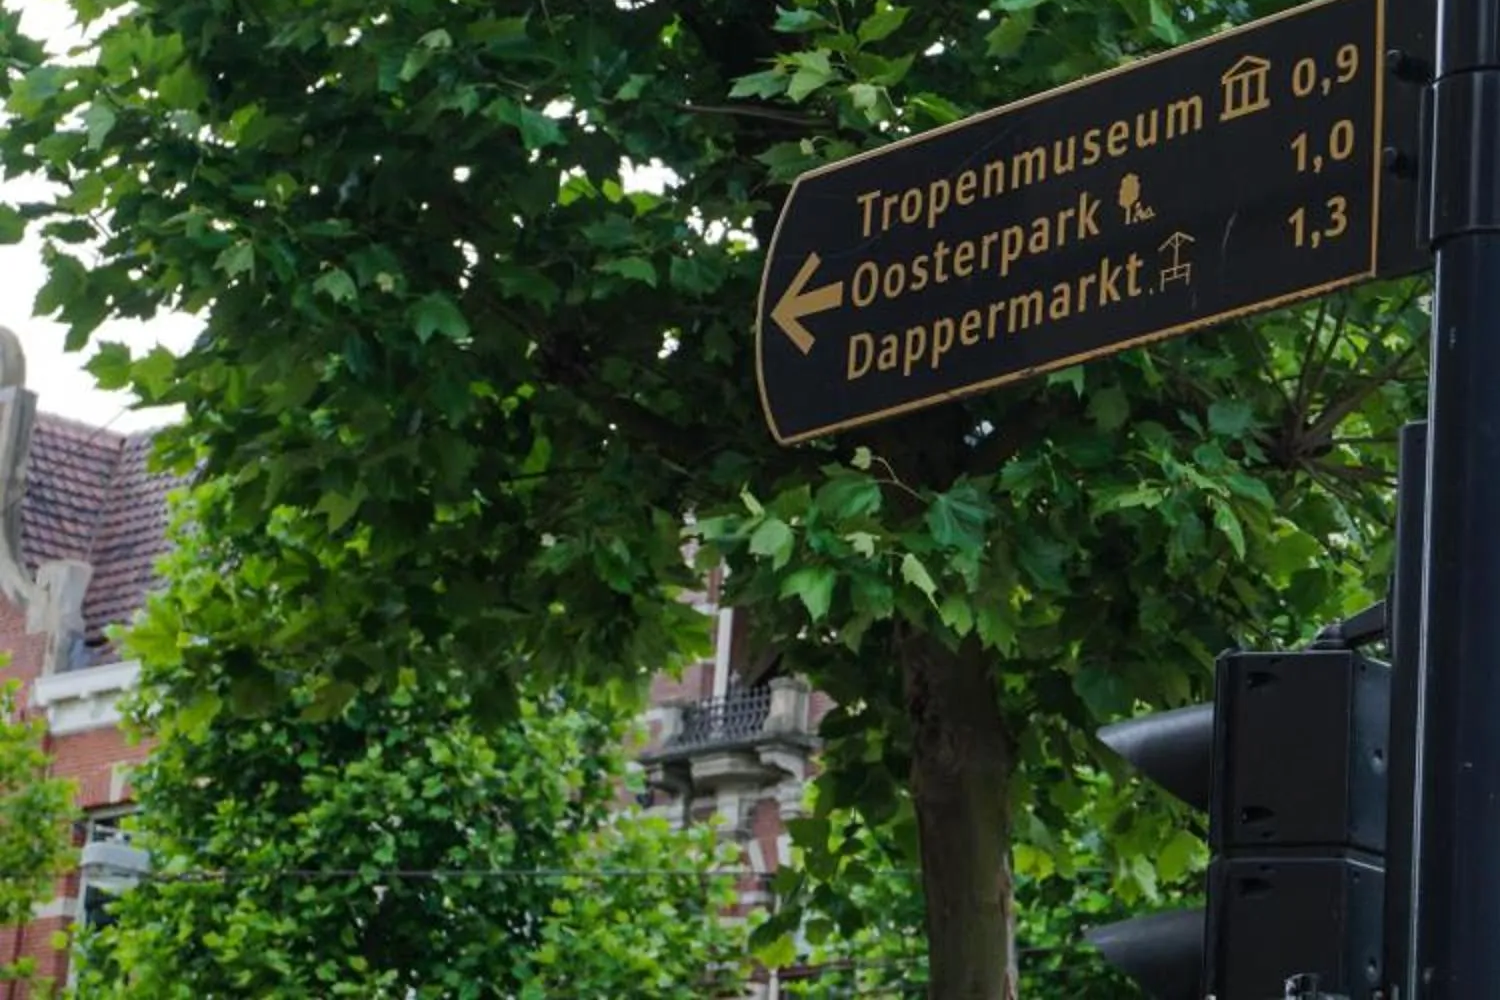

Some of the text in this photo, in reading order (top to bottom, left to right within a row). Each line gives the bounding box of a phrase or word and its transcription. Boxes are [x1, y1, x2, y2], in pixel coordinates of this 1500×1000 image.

[851, 118, 1355, 308] Oosterpark 1,0
[856, 43, 1359, 238] Tropenmuseum 0,9
[846, 195, 1348, 381] Dappermarkt 1,3
